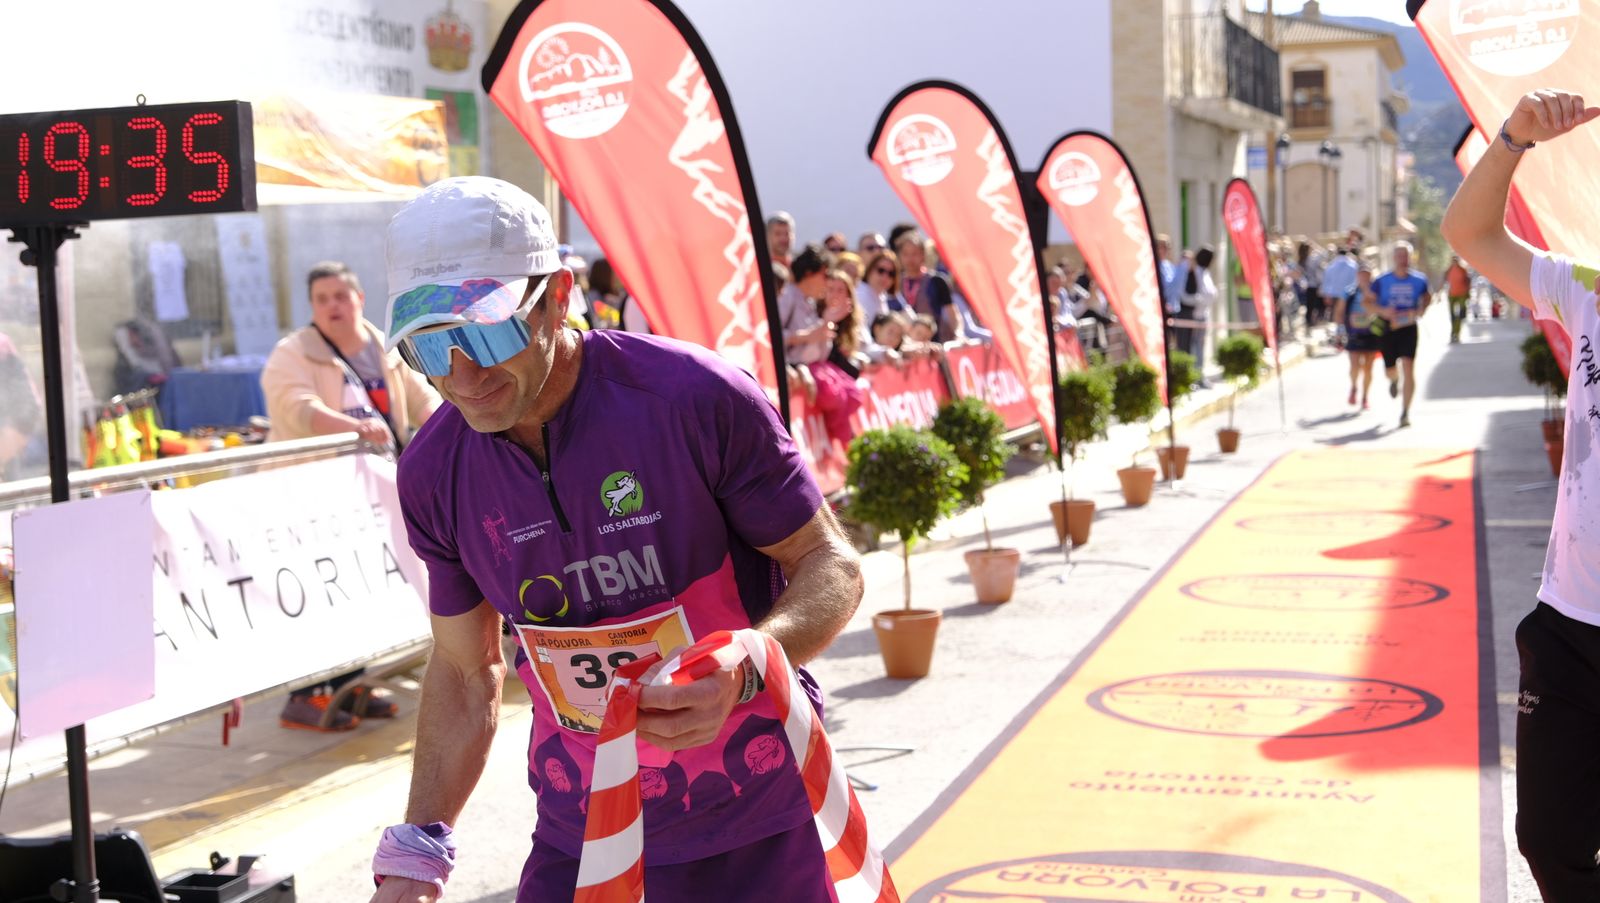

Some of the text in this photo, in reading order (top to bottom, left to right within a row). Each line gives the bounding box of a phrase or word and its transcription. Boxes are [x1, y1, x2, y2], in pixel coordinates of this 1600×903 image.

[16, 112, 231, 211] 19:35
[410, 263, 462, 280] Jhayber
[598, 510, 662, 536] LOS SALTABOJAS
[512, 528, 546, 544] PURCHENA
[563, 544, 666, 603] TBM
[608, 628, 647, 639] CANTORIA
[535, 636, 592, 648] LA PÓLVORA
[1290, 888, 1361, 903] LA
